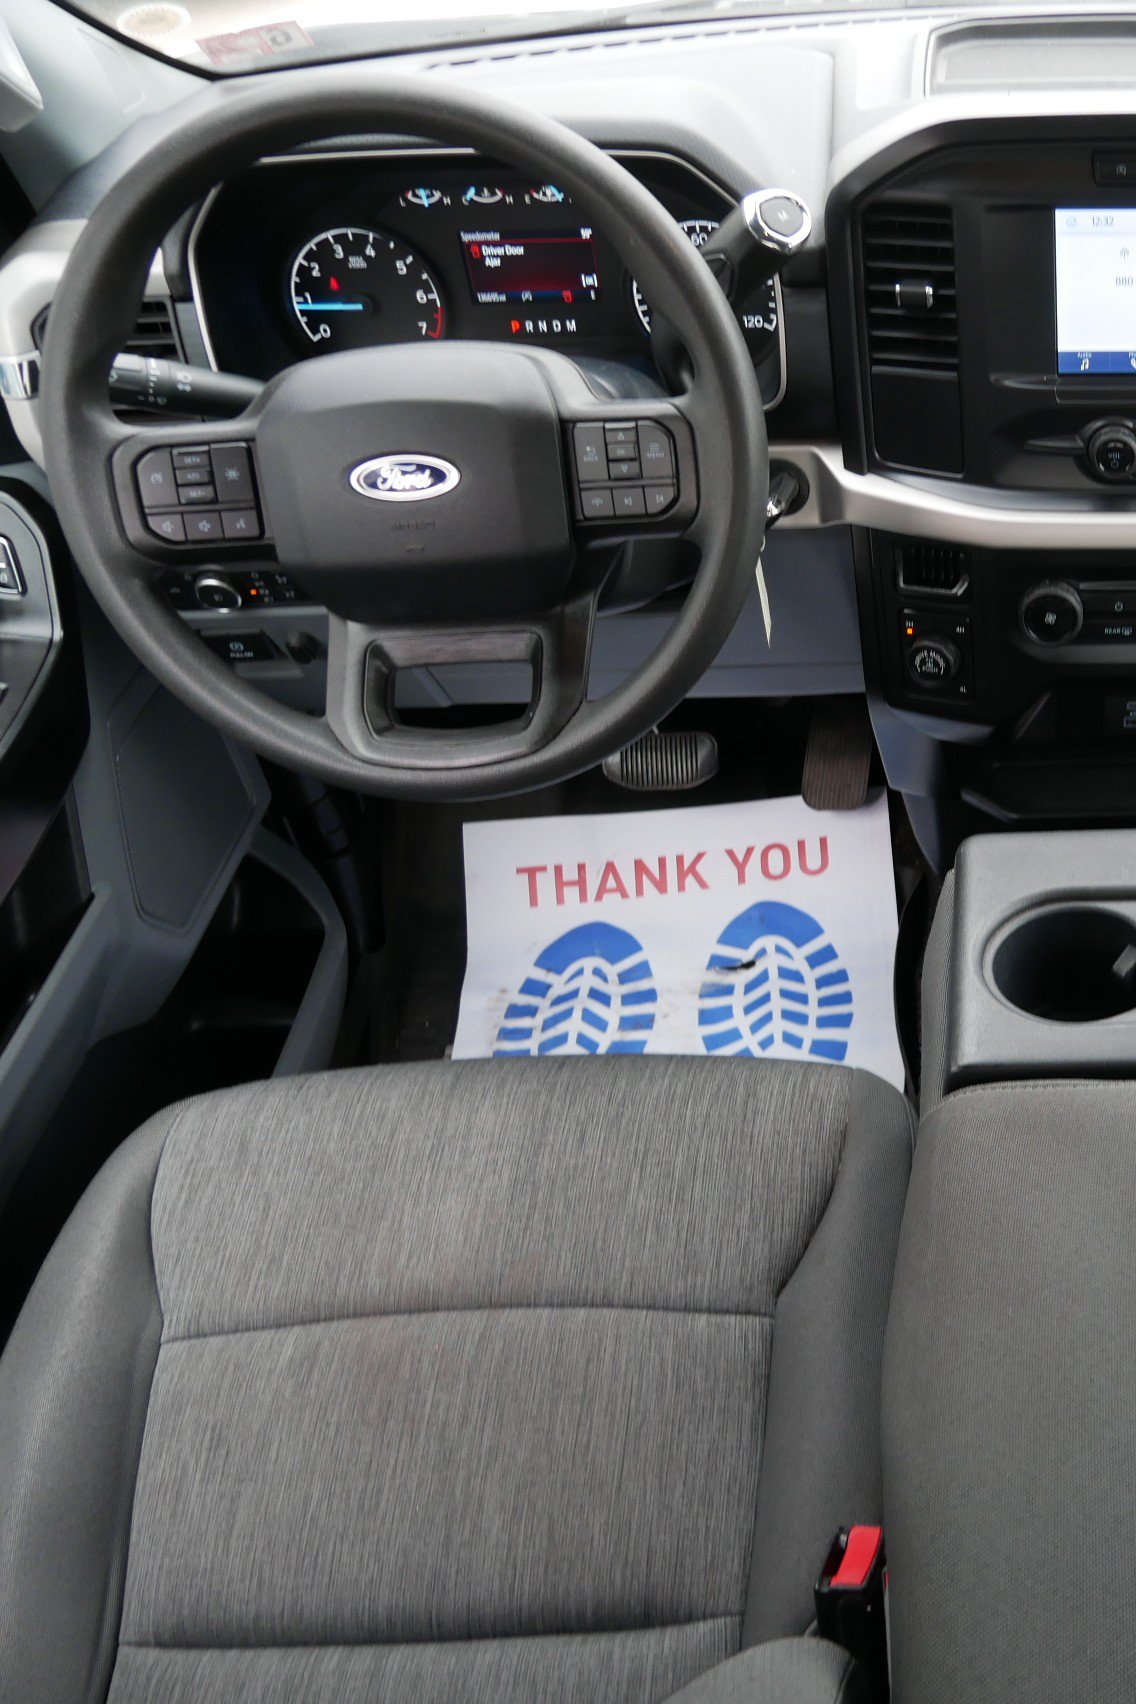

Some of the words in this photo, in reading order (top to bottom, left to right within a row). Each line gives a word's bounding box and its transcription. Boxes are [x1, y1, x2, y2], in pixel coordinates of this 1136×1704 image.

[333, 243, 344, 259] 3
[364, 243, 376, 258] 4
[481, 245, 504, 256] Driver
[505, 244, 524, 256] Door
[309, 262, 321, 277] 2
[396, 260, 407, 275] 5
[485, 257, 500, 268] Ajar
[304, 292, 312, 304] 1
[416, 290, 427, 304] 6
[417, 322, 427, 335] 7
[510, 320, 521, 334] P
[525, 320, 534, 333] R
[538, 320, 548, 333] N
[552, 319, 561, 333] D
[566, 319, 577, 333] M
[742, 315, 764, 328] 120
[319, 324, 330, 339] 0
[377, 463, 434, 491] Ford
[1104, 627, 1122, 636] REAR
[516, 851, 710, 908] THANK
[725, 836, 830, 885] YOU
